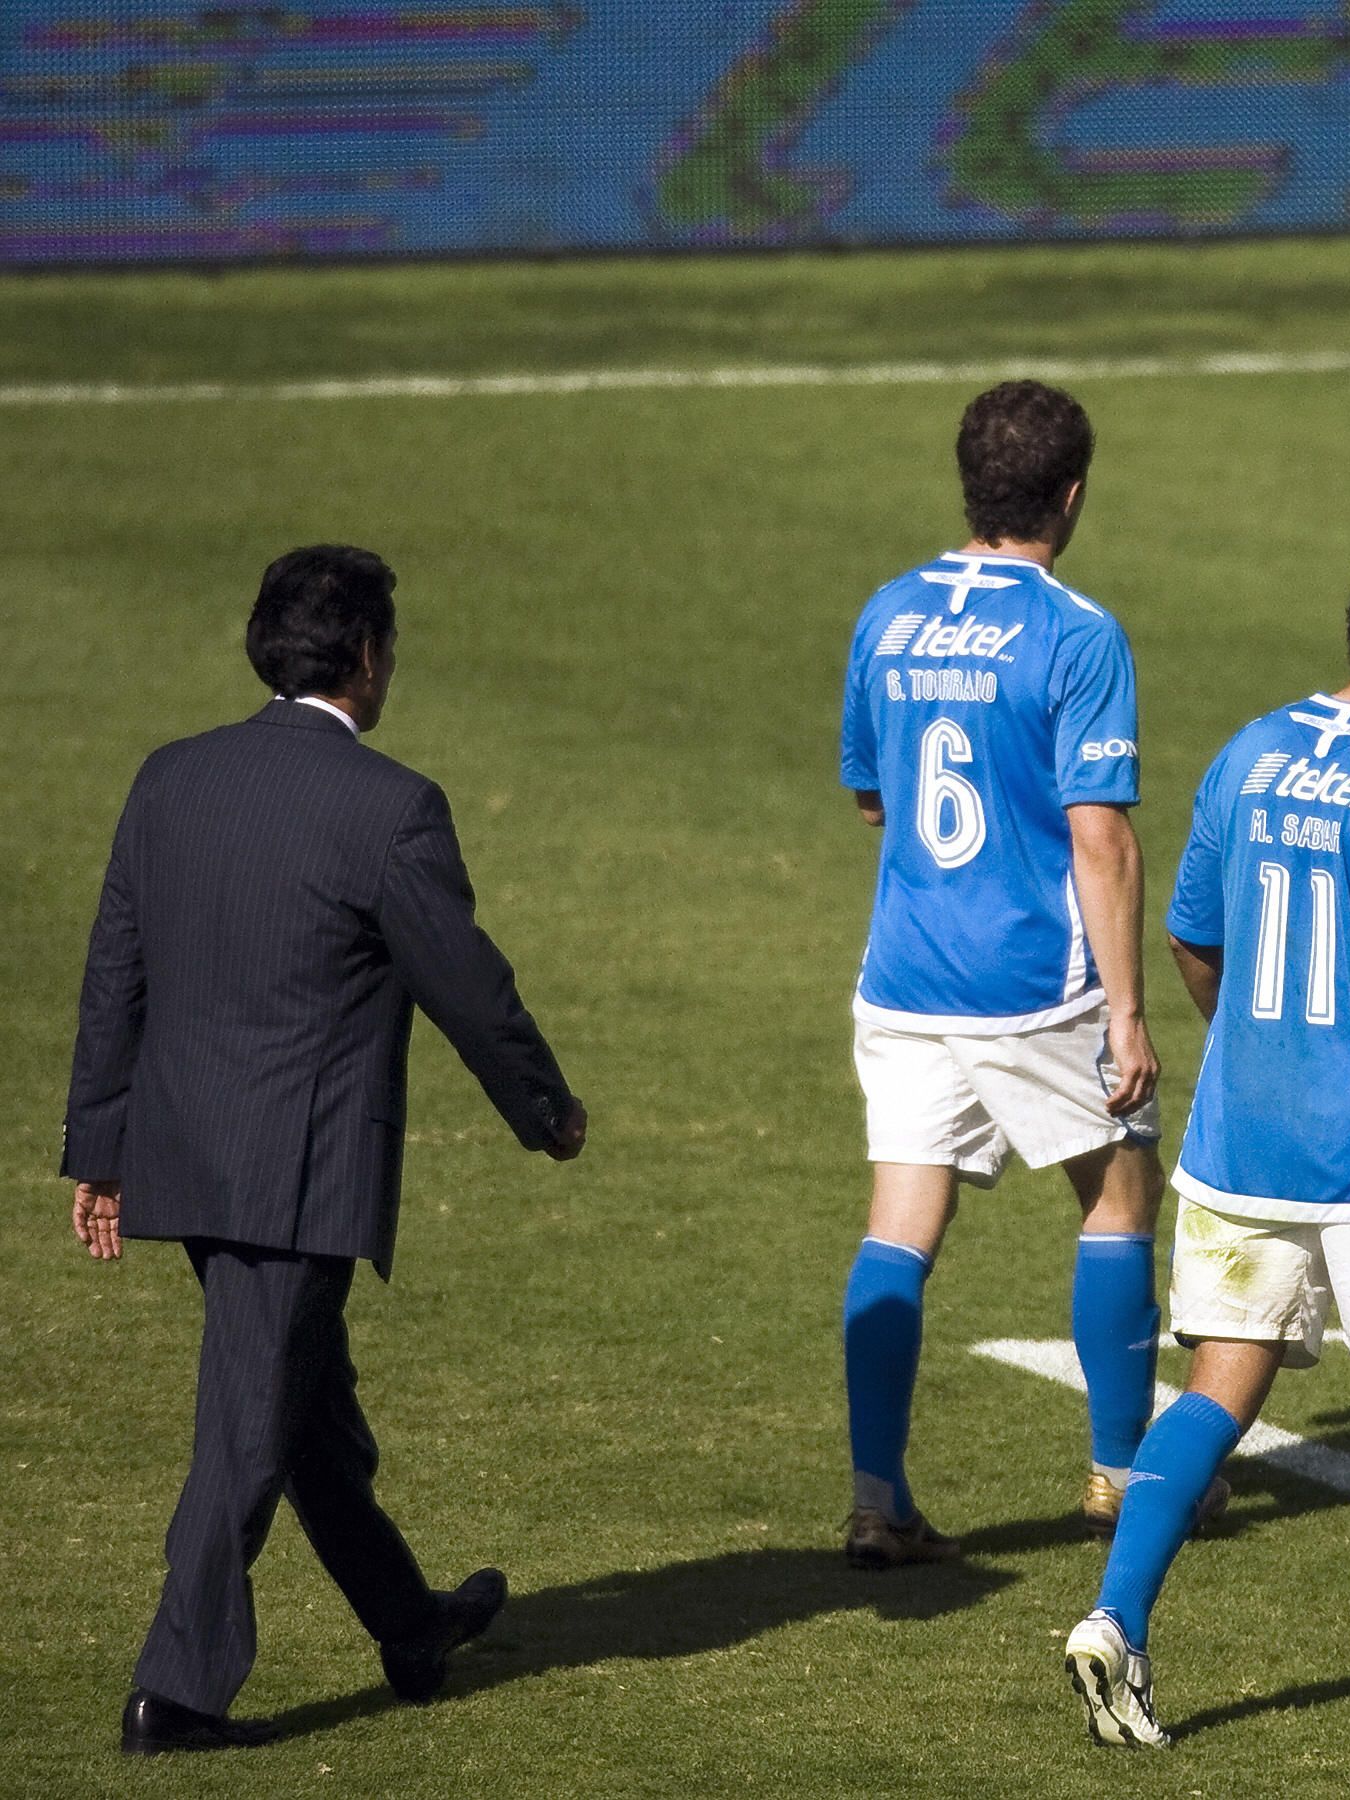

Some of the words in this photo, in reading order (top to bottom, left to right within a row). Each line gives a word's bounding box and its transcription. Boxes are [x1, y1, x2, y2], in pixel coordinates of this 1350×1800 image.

[911, 615, 1025, 658] telcel
[917, 717, 987, 869] 6
[1249, 808, 1274, 844] M.
[1281, 813, 1342, 855] SABAH
[1251, 861, 1336, 1026] 11
